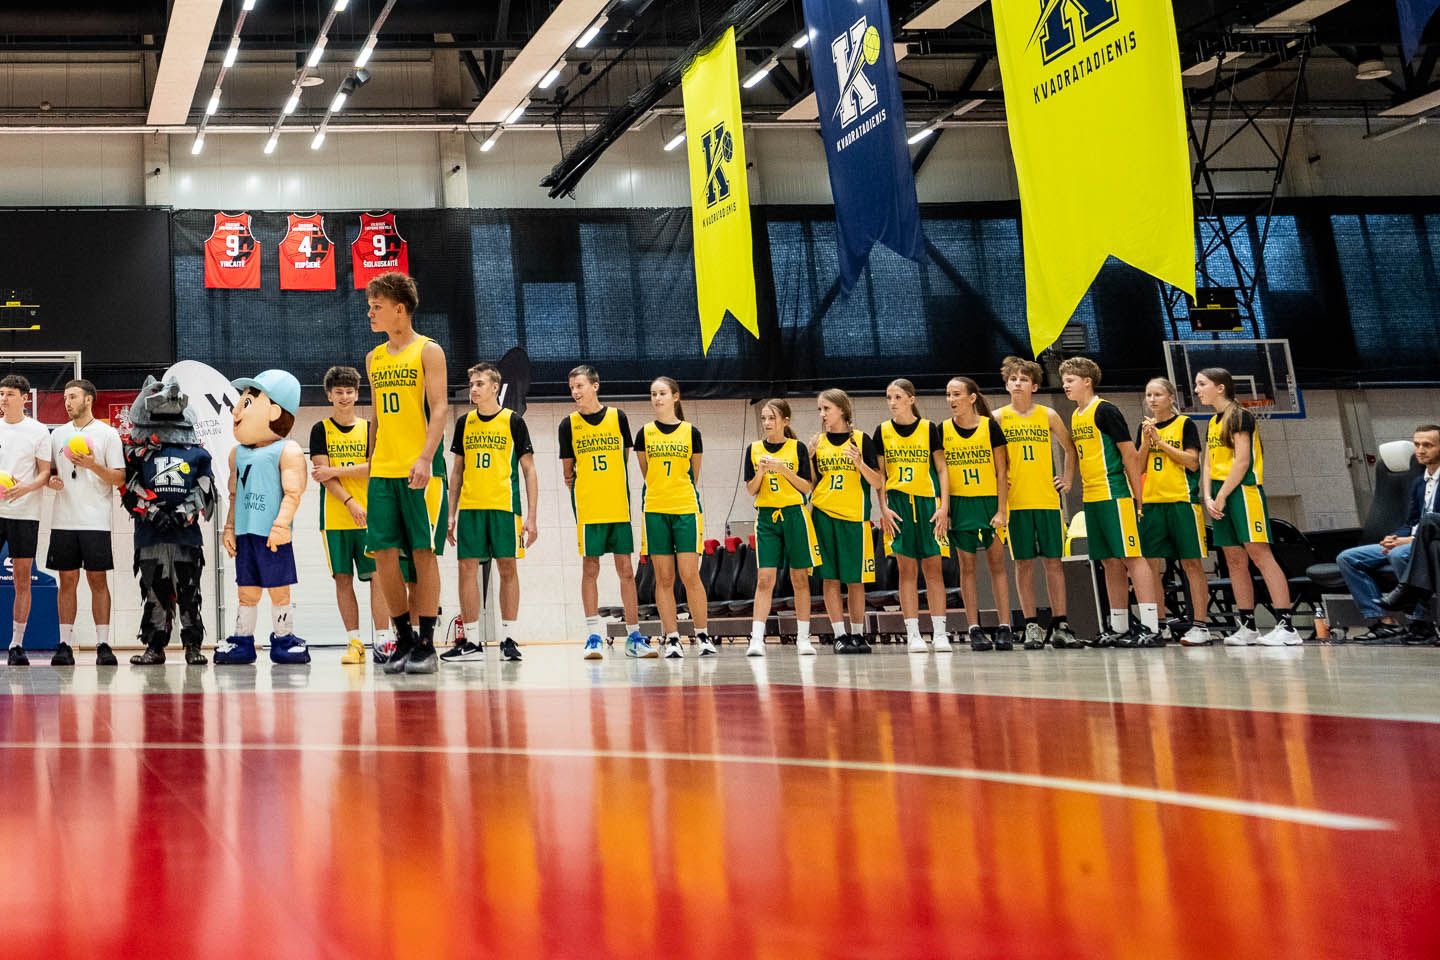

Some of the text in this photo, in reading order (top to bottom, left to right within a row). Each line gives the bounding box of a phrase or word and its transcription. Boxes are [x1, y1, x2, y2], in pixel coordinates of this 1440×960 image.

[1033, 31, 1136, 104] KVADRATADIENIS
[836, 108, 886, 152] KVADRATADIENIS
[226, 234, 239, 257] 9
[298, 235, 312, 258] 4
[372, 234, 387, 257] 9
[382, 392, 400, 414] 10
[466, 435, 507, 445] ŽEMYNOS
[1004, 428, 1049, 438] ŽEMYNOS
[575, 436, 620, 449] ŽEMYNOS
[577, 445, 620, 455] PROGIMNAZIJA
[646, 443, 689, 454] ŽEMYNOS
[475, 452, 491, 469] 18
[885, 449, 929, 458] ŽEMYNOS
[945, 449, 991, 461] ŽEMYNOS
[1022, 445, 1035, 461] 11
[592, 455, 608, 472] 15
[663, 460, 672, 477] 7
[1153, 456, 1163, 471] 8
[898, 466, 913, 482] 13
[962, 468, 980, 485] 14
[769, 478, 779, 492] 5
[829, 474, 844, 491] 12
[1254, 521, 1263, 533] 6
[1128, 535, 1136, 547] 9
